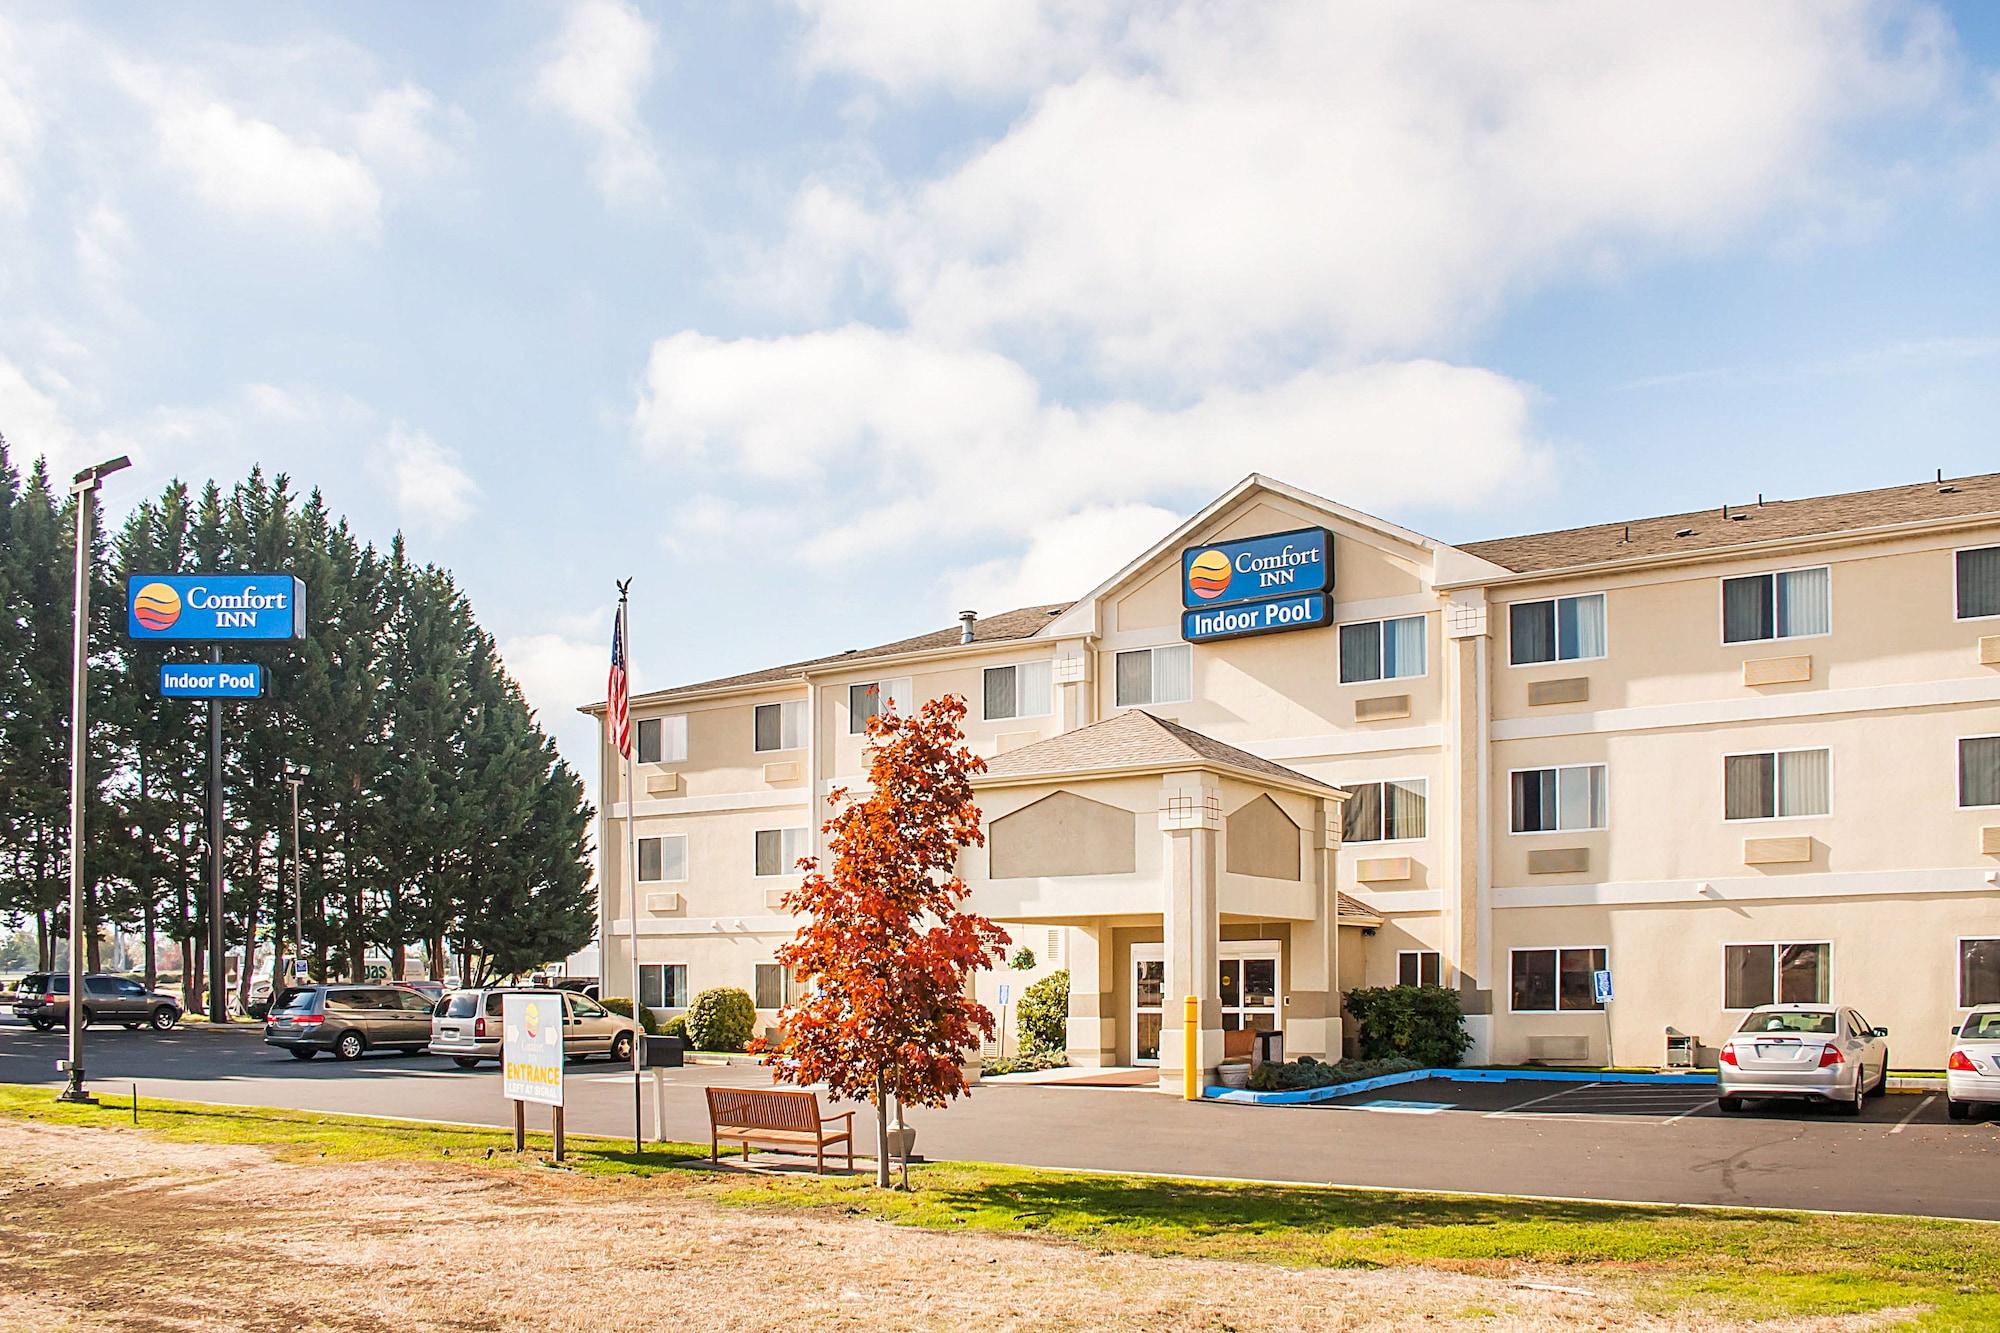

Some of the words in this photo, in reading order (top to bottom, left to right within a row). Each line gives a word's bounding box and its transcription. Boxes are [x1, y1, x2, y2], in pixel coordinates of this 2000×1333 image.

[1235, 545, 1320, 573] Comfort
[1259, 569, 1295, 587] INN
[187, 586, 287, 609] Comfort
[216, 611, 257, 628] INN
[1195, 610, 1259, 635] Indoor
[1265, 598, 1312, 625] Pool
[164, 673, 215, 689] Indoor
[219, 673, 255, 689] Pool
[507, 1062, 560, 1085] ENTRANCE
